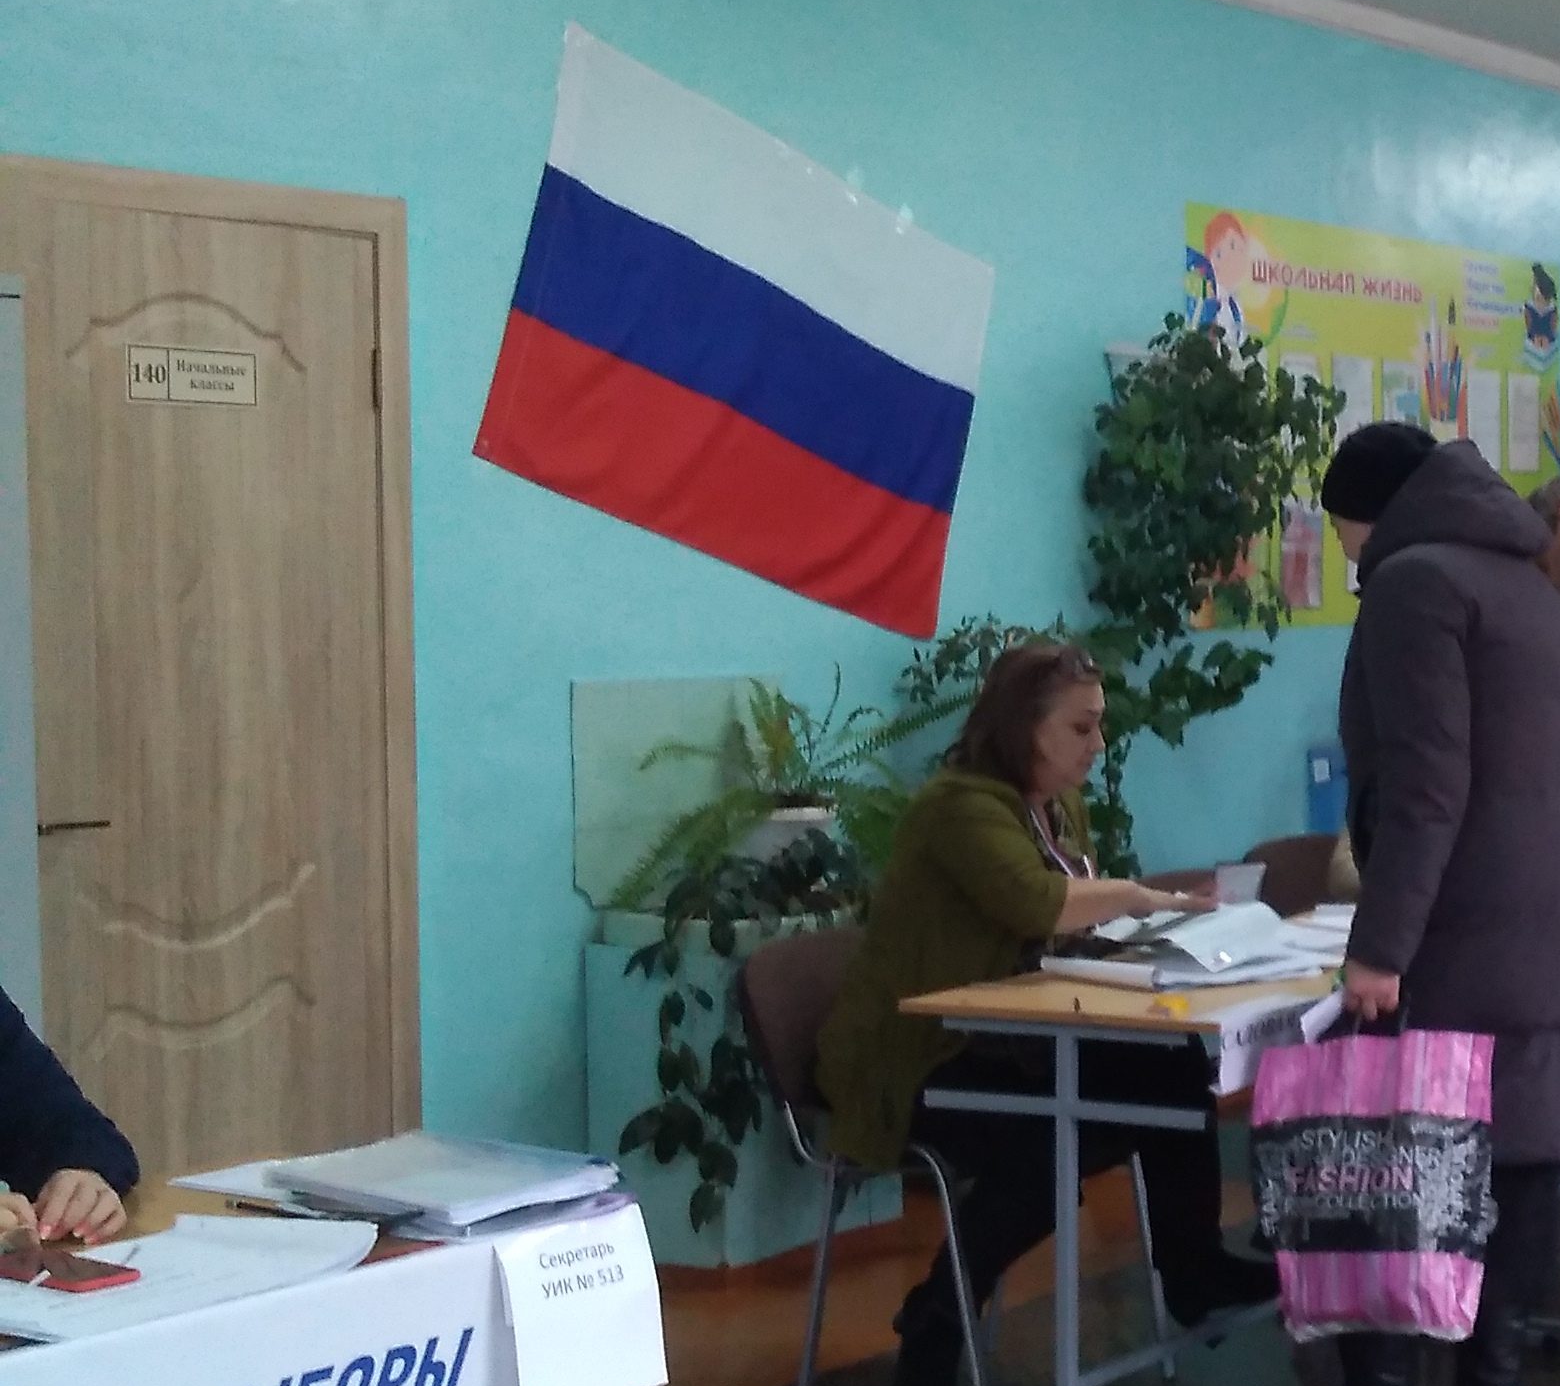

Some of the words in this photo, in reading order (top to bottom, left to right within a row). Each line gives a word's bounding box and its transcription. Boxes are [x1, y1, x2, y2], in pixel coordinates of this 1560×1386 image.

[1252, 258, 1355, 294] ШКОЛЬНАЯ
[1362, 275, 1423, 304] ЖИЗНЬ
[133, 363, 166, 384] 140
[176, 359, 247, 376] Начальные
[1286, 1164, 1415, 1193] FASHION
[539, 1242, 615, 1269] Секретарь
[541, 1278, 574, 1299] УИК
[576, 1274, 595, 1291] №
[598, 1264, 625, 1286] 513
